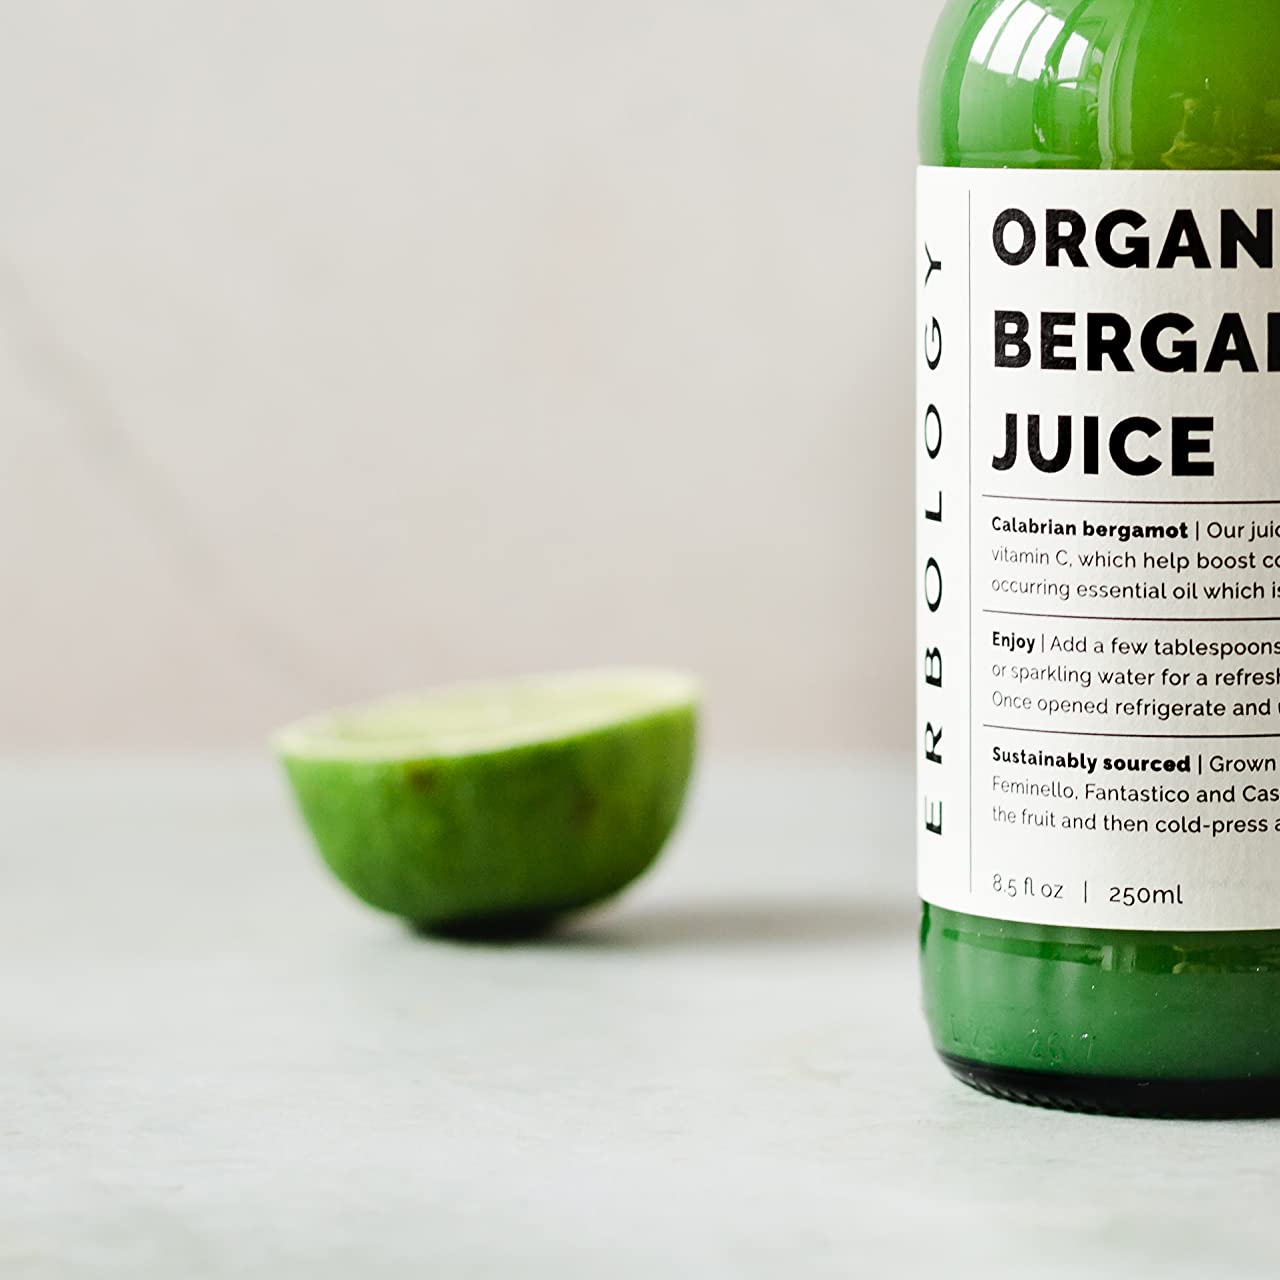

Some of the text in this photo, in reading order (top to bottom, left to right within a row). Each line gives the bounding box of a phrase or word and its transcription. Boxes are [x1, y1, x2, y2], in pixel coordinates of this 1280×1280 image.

[990, 412, 1215, 477] JUICE
[923, 239, 943, 839] ERBOLOGY
[991, 516, 1077, 536] Calabrian
[1082, 520, 1189, 543] bergamot
[1206, 521, 1245, 539] Our
[991, 546, 1050, 565] vitamin
[1055, 550, 1073, 568] C,
[1078, 551, 1136, 569] which
[1143, 552, 1190, 574] help
[1197, 553, 1256, 569] boost
[991, 578, 1070, 600] occurring
[1076, 581, 1167, 599] essential
[1172, 583, 1198, 599] oil
[1204, 583, 1265, 599] which
[992, 631, 1036, 654] Enjoy
[1050, 635, 1087, 653] Add
[1094, 640, 1104, 654] a
[1111, 637, 1148, 655] few
[992, 663, 1007, 678] or
[1011, 666, 1091, 687] sparkling
[1097, 670, 1155, 685] water
[1161, 668, 1191, 686] for
[1196, 673, 1208, 686] a
[992, 690, 1032, 709] Once
[1037, 698, 1108, 716] opened
[1115, 697, 1226, 720] refrigerate
[1232, 699, 1271, 716] and
[992, 746, 1097, 774] Sustainably
[1103, 755, 1191, 772] sourced
[1210, 755, 1276, 772] Grown
[992, 776, 1079, 800] Feminello,
[1085, 783, 1190, 803] Fantastico
[1196, 785, 1236, 803] and
[992, 806, 1016, 824] the
[1021, 808, 1056, 827] fruit
[1061, 814, 1097, 831] and
[1103, 815, 1148, 832] then
[1155, 816, 1268, 837] cold-press
[992, 873, 1017, 897] 8.5
[1024, 876, 1035, 896] fl
[1041, 882, 1064, 899] oz
[1109, 884, 1183, 907] 250ml
